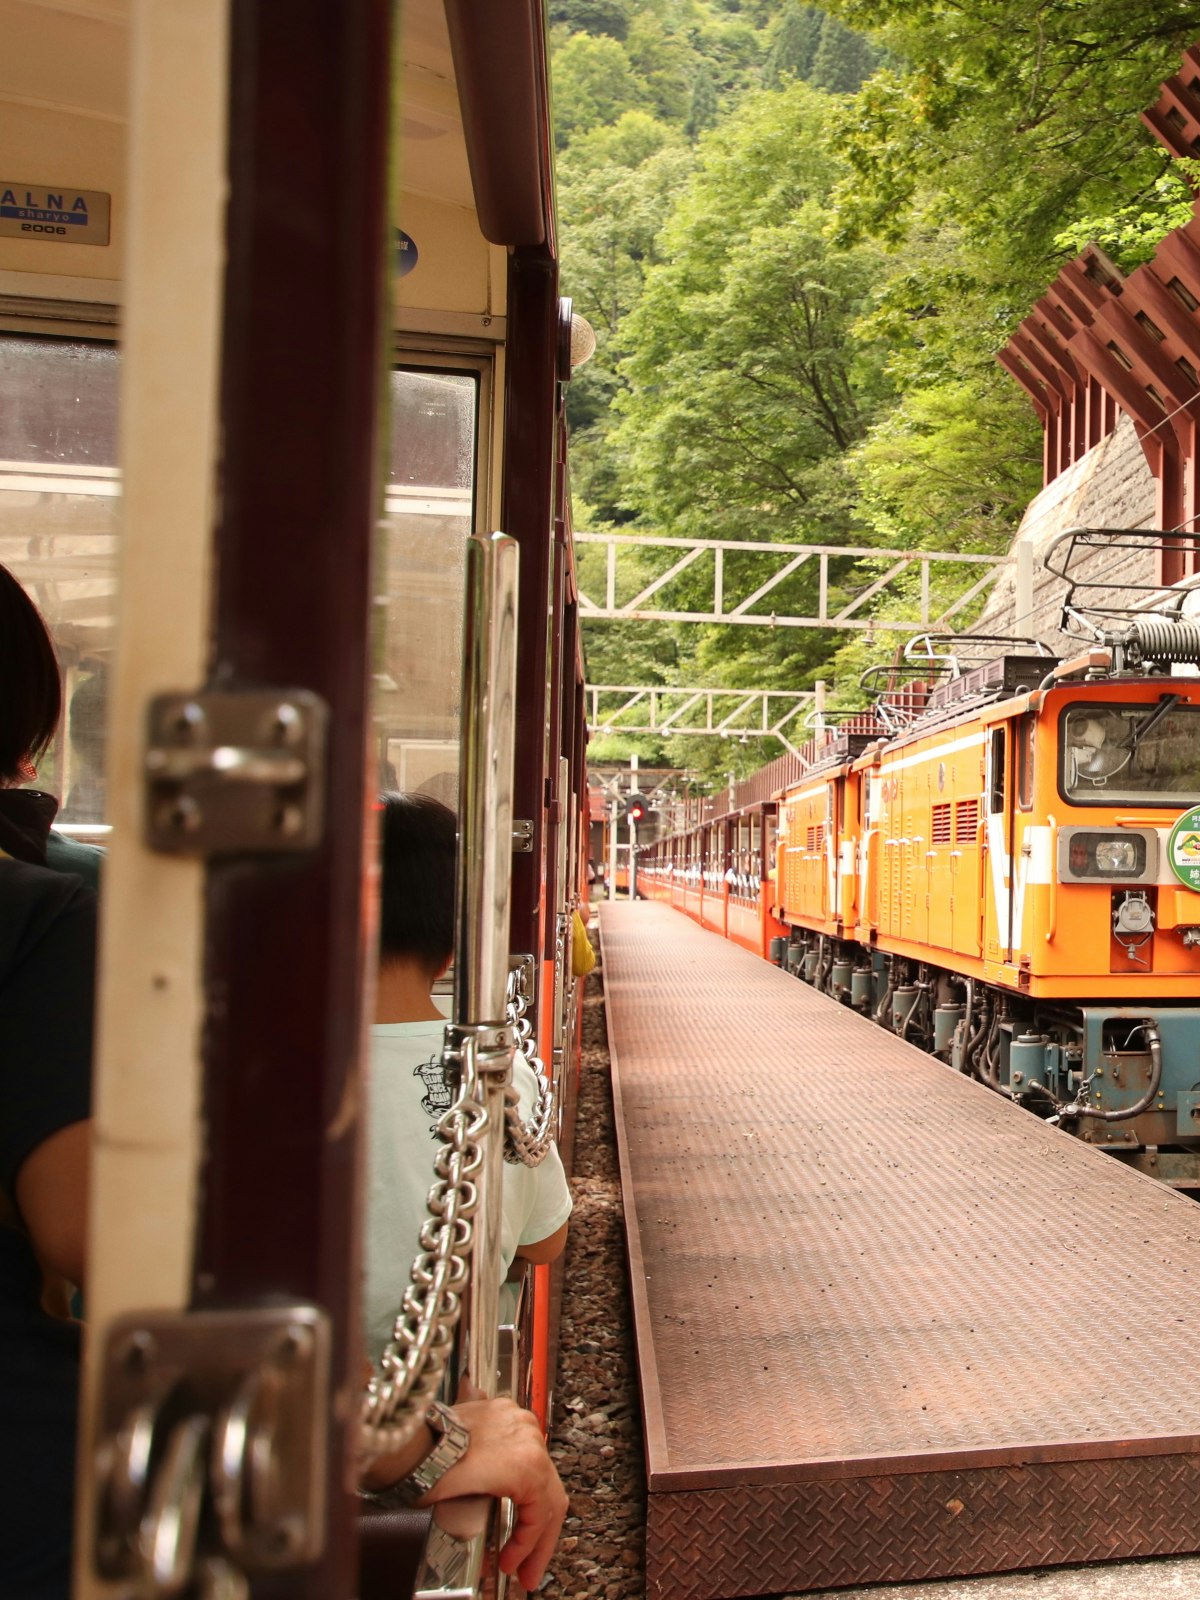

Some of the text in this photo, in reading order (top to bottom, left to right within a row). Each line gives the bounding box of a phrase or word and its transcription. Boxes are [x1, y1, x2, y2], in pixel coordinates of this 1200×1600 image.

[1, 190, 88, 212] ALNA
[18, 210, 70, 221] sharyo
[21, 223, 67, 235] 2006
